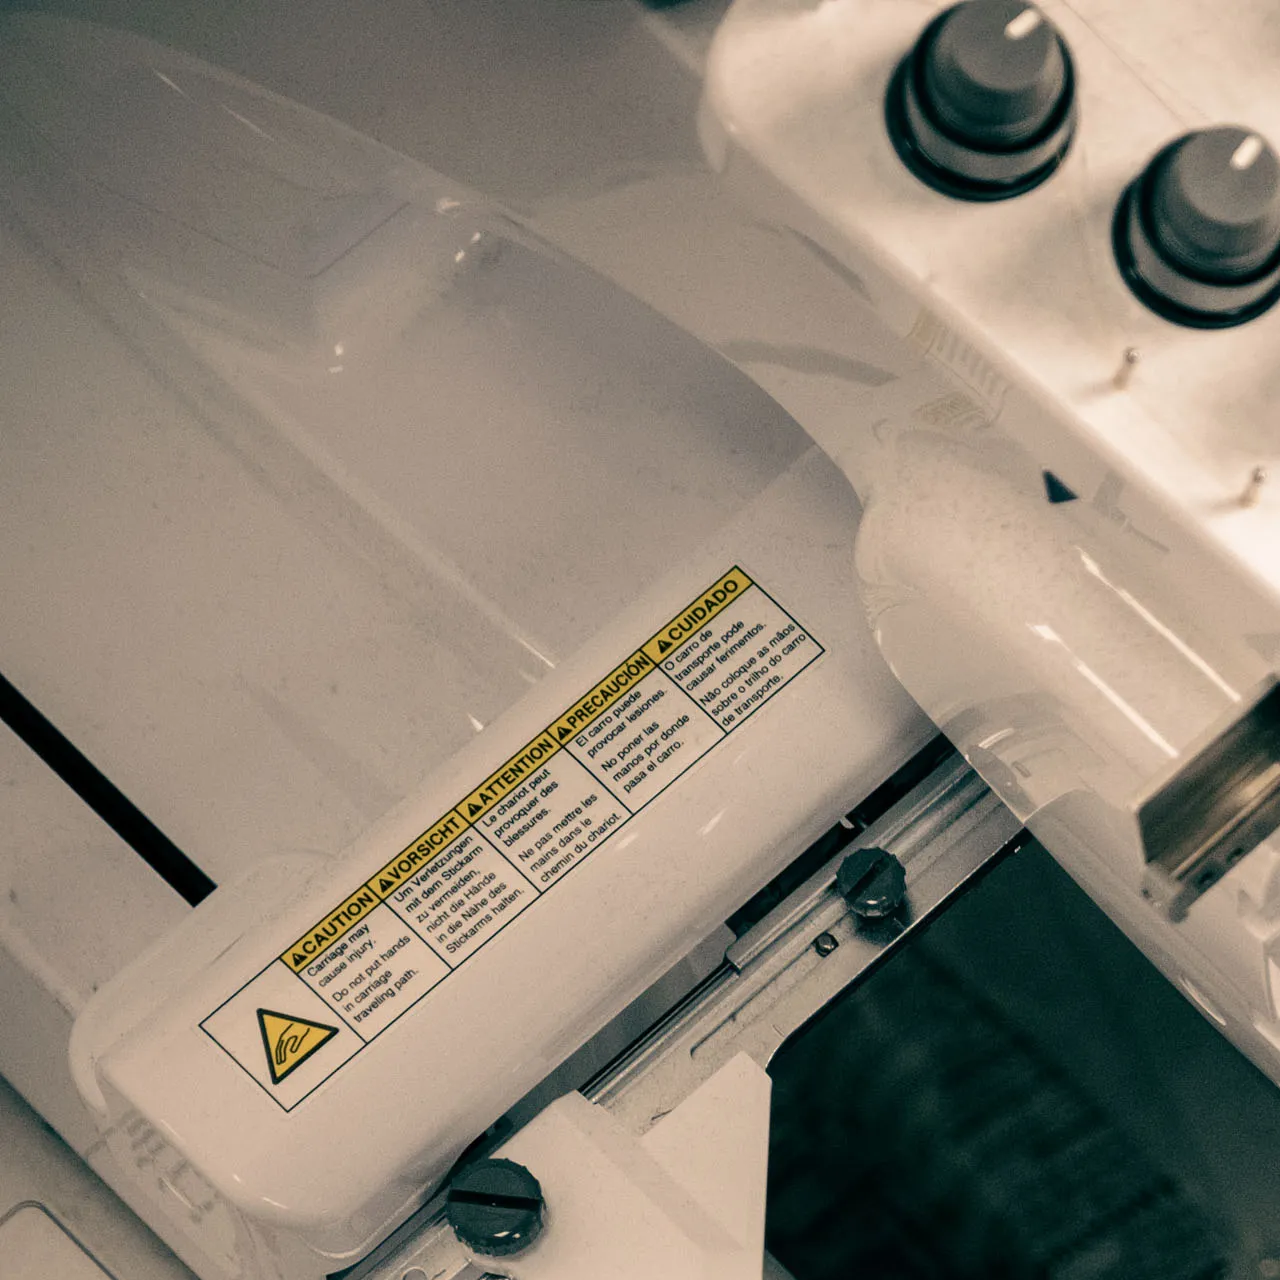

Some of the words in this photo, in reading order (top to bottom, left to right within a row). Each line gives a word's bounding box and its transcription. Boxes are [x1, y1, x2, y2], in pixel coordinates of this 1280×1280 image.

[667, 579, 738, 640] CUIDADO
[663, 660, 675, 671] O
[674, 640, 699, 663] carro
[698, 629, 713, 642] de
[673, 641, 721, 681] transporte
[720, 620, 744, 644] pode
[685, 662, 716, 691] causar
[714, 623, 766, 664] ferimentos.
[710, 692, 738, 716] sobre
[737, 685, 746, 693] o
[743, 665, 769, 687] trilho
[768, 654, 782, 667] do
[781, 633, 806, 655] carro
[720, 656, 757, 688] coloque
[756, 645, 770, 658] as
[566, 655, 650, 728] PRECAUCIÓN
[574, 734, 589, 747] El
[587, 715, 613, 738] carro
[612, 690, 641, 718] puede
[721, 713, 735, 726] de
[733, 674, 783, 715] transporte.
[586, 721, 626, 759] provocar
[624, 689, 665, 723] lesiones.
[600, 757, 618, 772] No
[616, 733, 644, 760] poner
[641, 721, 659, 736] las
[612, 753, 644, 782] manos
[643, 738, 660, 757] por
[659, 714, 689, 741] donde
[478, 738, 553, 805] ATTENTION
[481, 814, 497, 827] Le
[496, 786, 529, 816] chariot
[527, 768, 551, 790] peut
[622, 770, 647, 794] pasa
[646, 759, 657, 772] el
[656, 740, 684, 763] carro.
[493, 796, 539, 839] provoquer
[539, 780, 558, 798] des
[502, 808, 549, 847] blessures.
[517, 847, 534, 862] Ne
[533, 832, 553, 851] pas
[552, 806, 583, 833] mettre
[579, 793, 598, 808] les
[387, 816, 459, 879] VORSICHT
[393, 886, 414, 902] Um
[410, 835, 472, 886] Verletzungen
[529, 846, 559, 872] mains
[558, 826, 582, 848] dans
[579, 817, 592, 828] le
[540, 852, 574, 882] chemin
[573, 840, 588, 854] du
[587, 812, 621, 842] chariot.
[404, 896, 422, 913] mit
[420, 879, 443, 899] dem
[440, 845, 483, 881] Stickarm
[415, 910, 429, 923] zu
[428, 869, 480, 911] vermeiden,
[425, 910, 450, 933] nicht
[448, 898, 465, 913] die
[462, 872, 496, 900] Hände
[301, 892, 373, 954] CAUTION
[435, 932, 447, 943] in
[446, 919, 463, 934] die
[460, 897, 488, 921] Nähe
[487, 882, 507, 899] des
[445, 913, 493, 953] Stickarms
[490, 888, 524, 915] halten.
[306, 942, 348, 976] Carriage
[347, 923, 370, 943] may
[318, 961, 347, 987] cause
[346, 938, 376, 963] injury.
[331, 987, 349, 1002] Do
[348, 972, 366, 989] not
[364, 959, 382, 977] put
[378, 935, 411, 961] hands
[342, 1001, 355, 1013] in
[353, 970, 392, 1003] carriage
[352, 987, 396, 1023] traveling
[393, 969, 418, 991] path.
